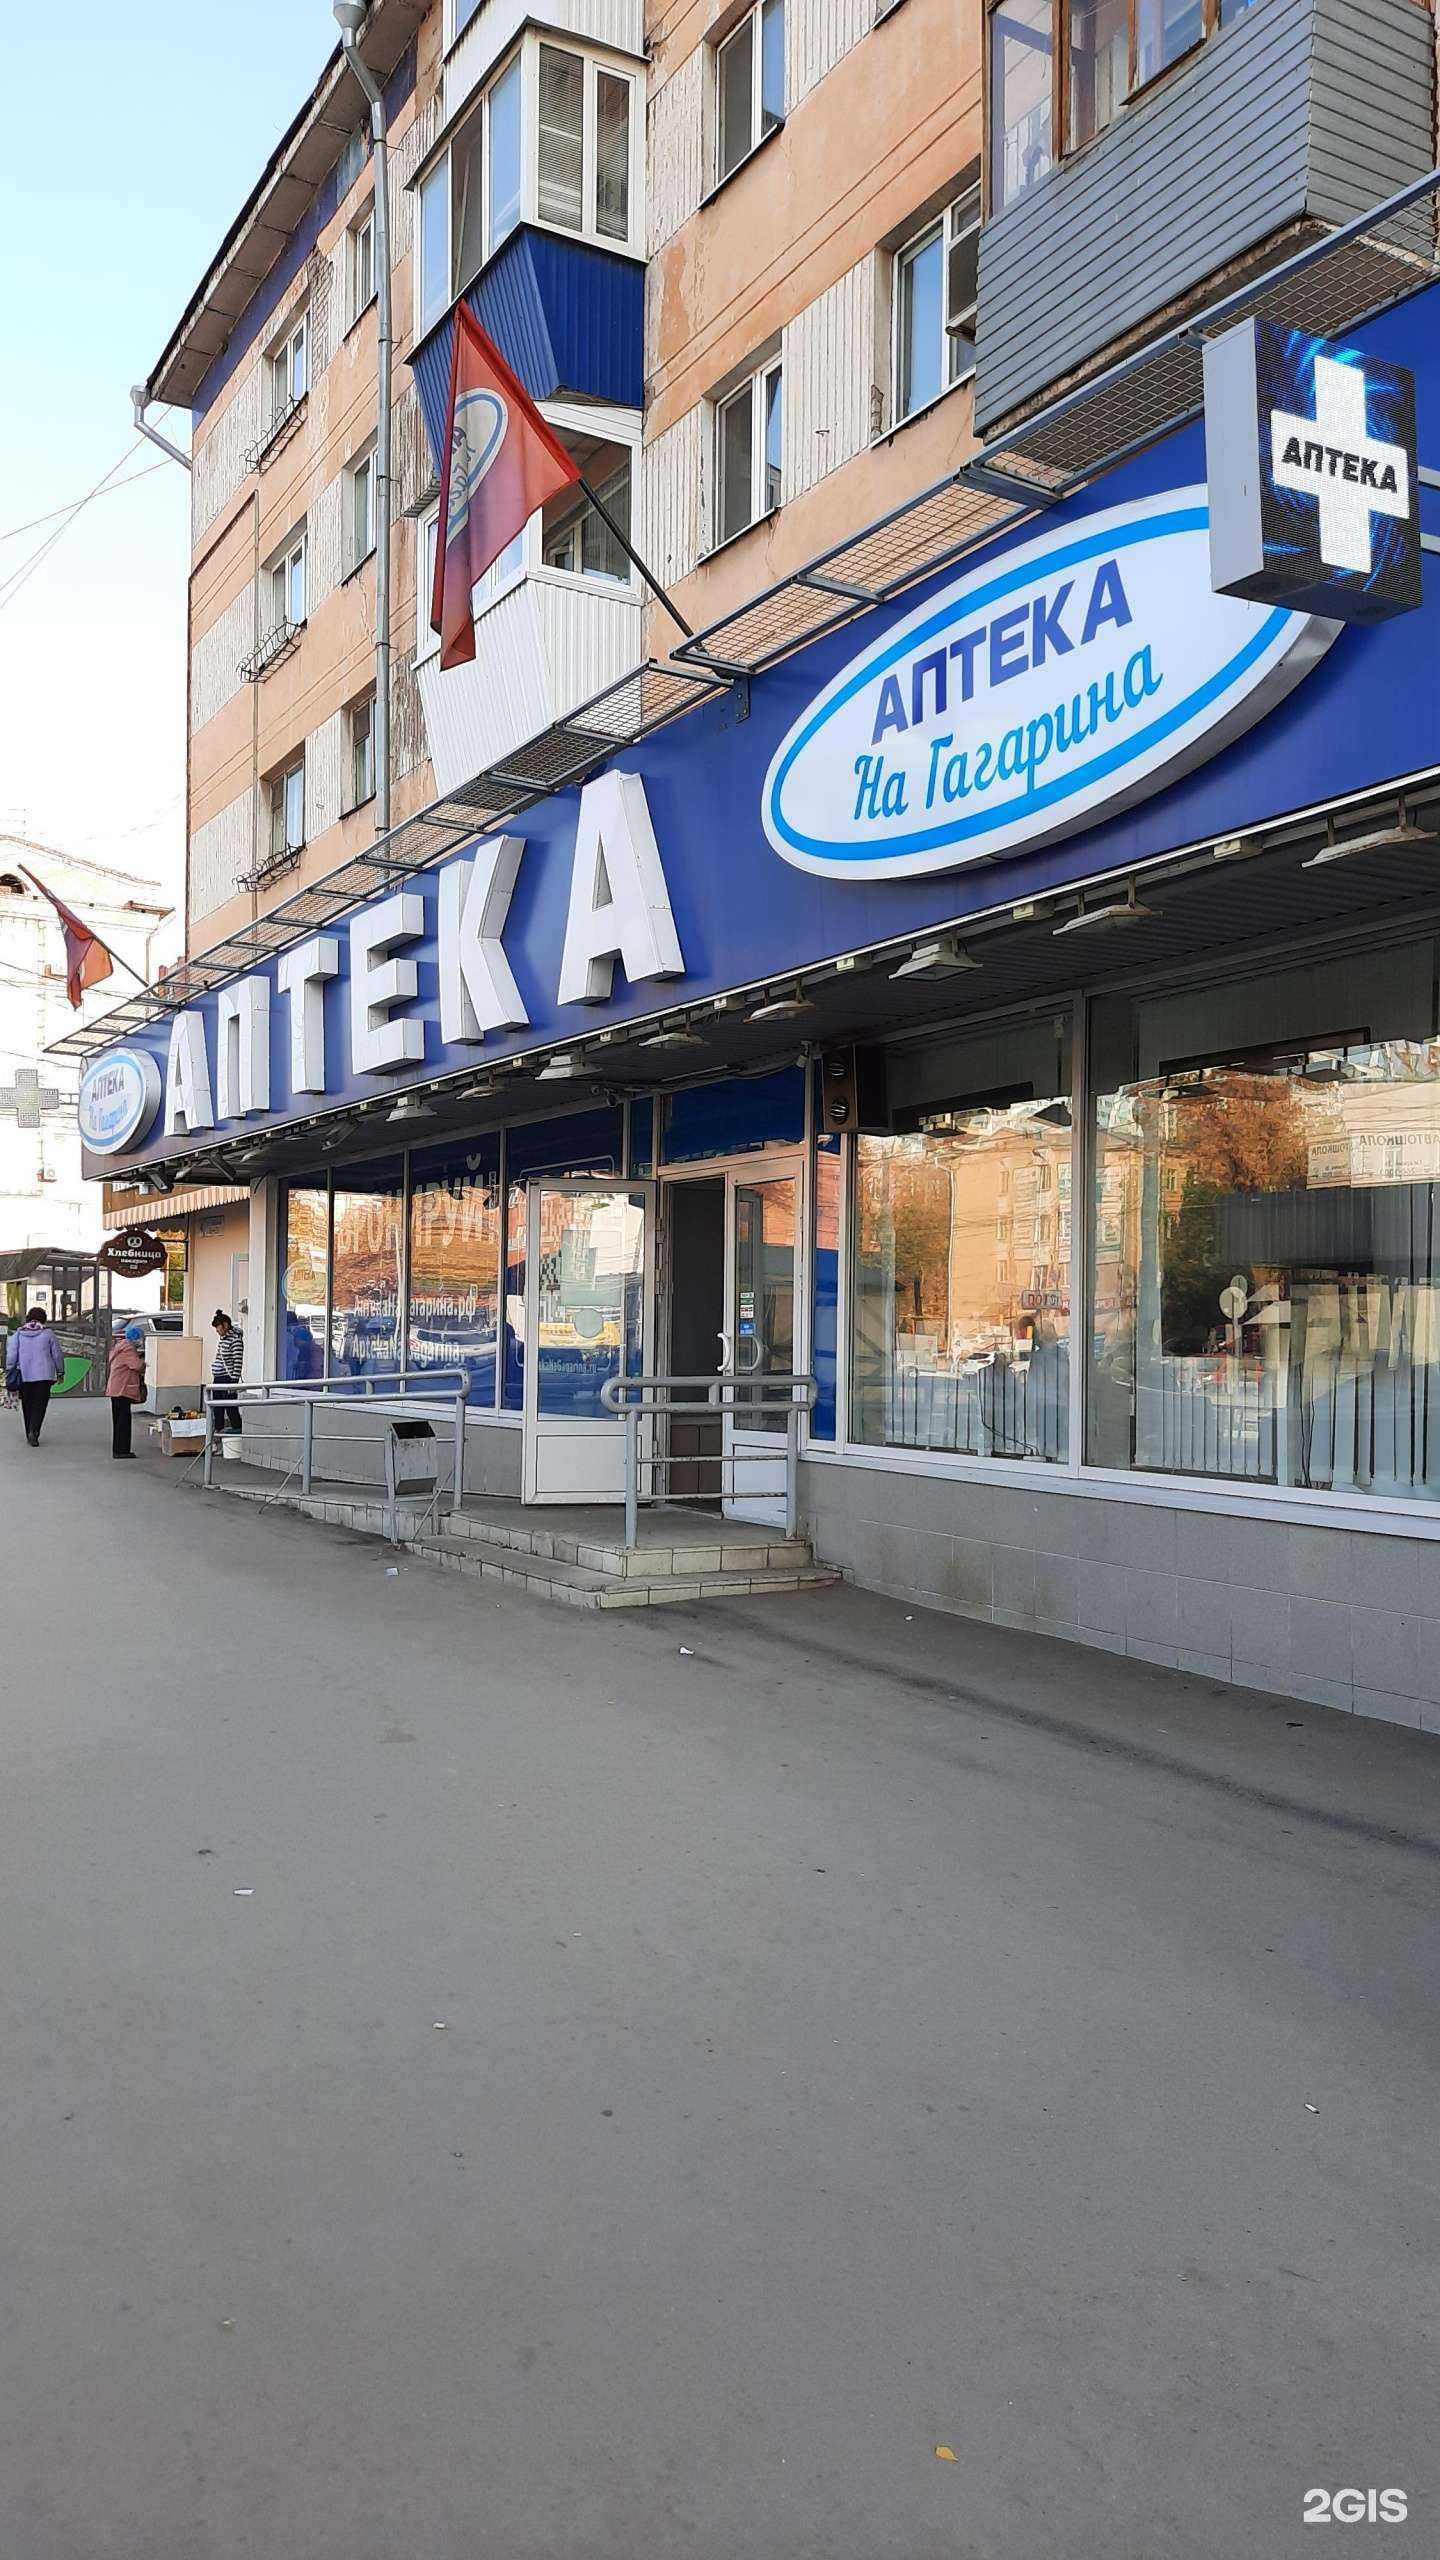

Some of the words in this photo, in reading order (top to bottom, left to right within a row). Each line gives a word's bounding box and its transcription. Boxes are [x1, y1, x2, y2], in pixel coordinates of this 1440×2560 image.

[1282, 436, 1398, 494] АПТЕКА
[872, 558, 1133, 746] АПТЕКА
[853, 753, 908, 820] На
[924, 644, 1163, 810] Гагарина
[164, 769, 686, 1137] АПТЕКА
[91, 1067, 125, 1102] АПТЕКА
[107, 1247, 162, 1260] Хлебница
